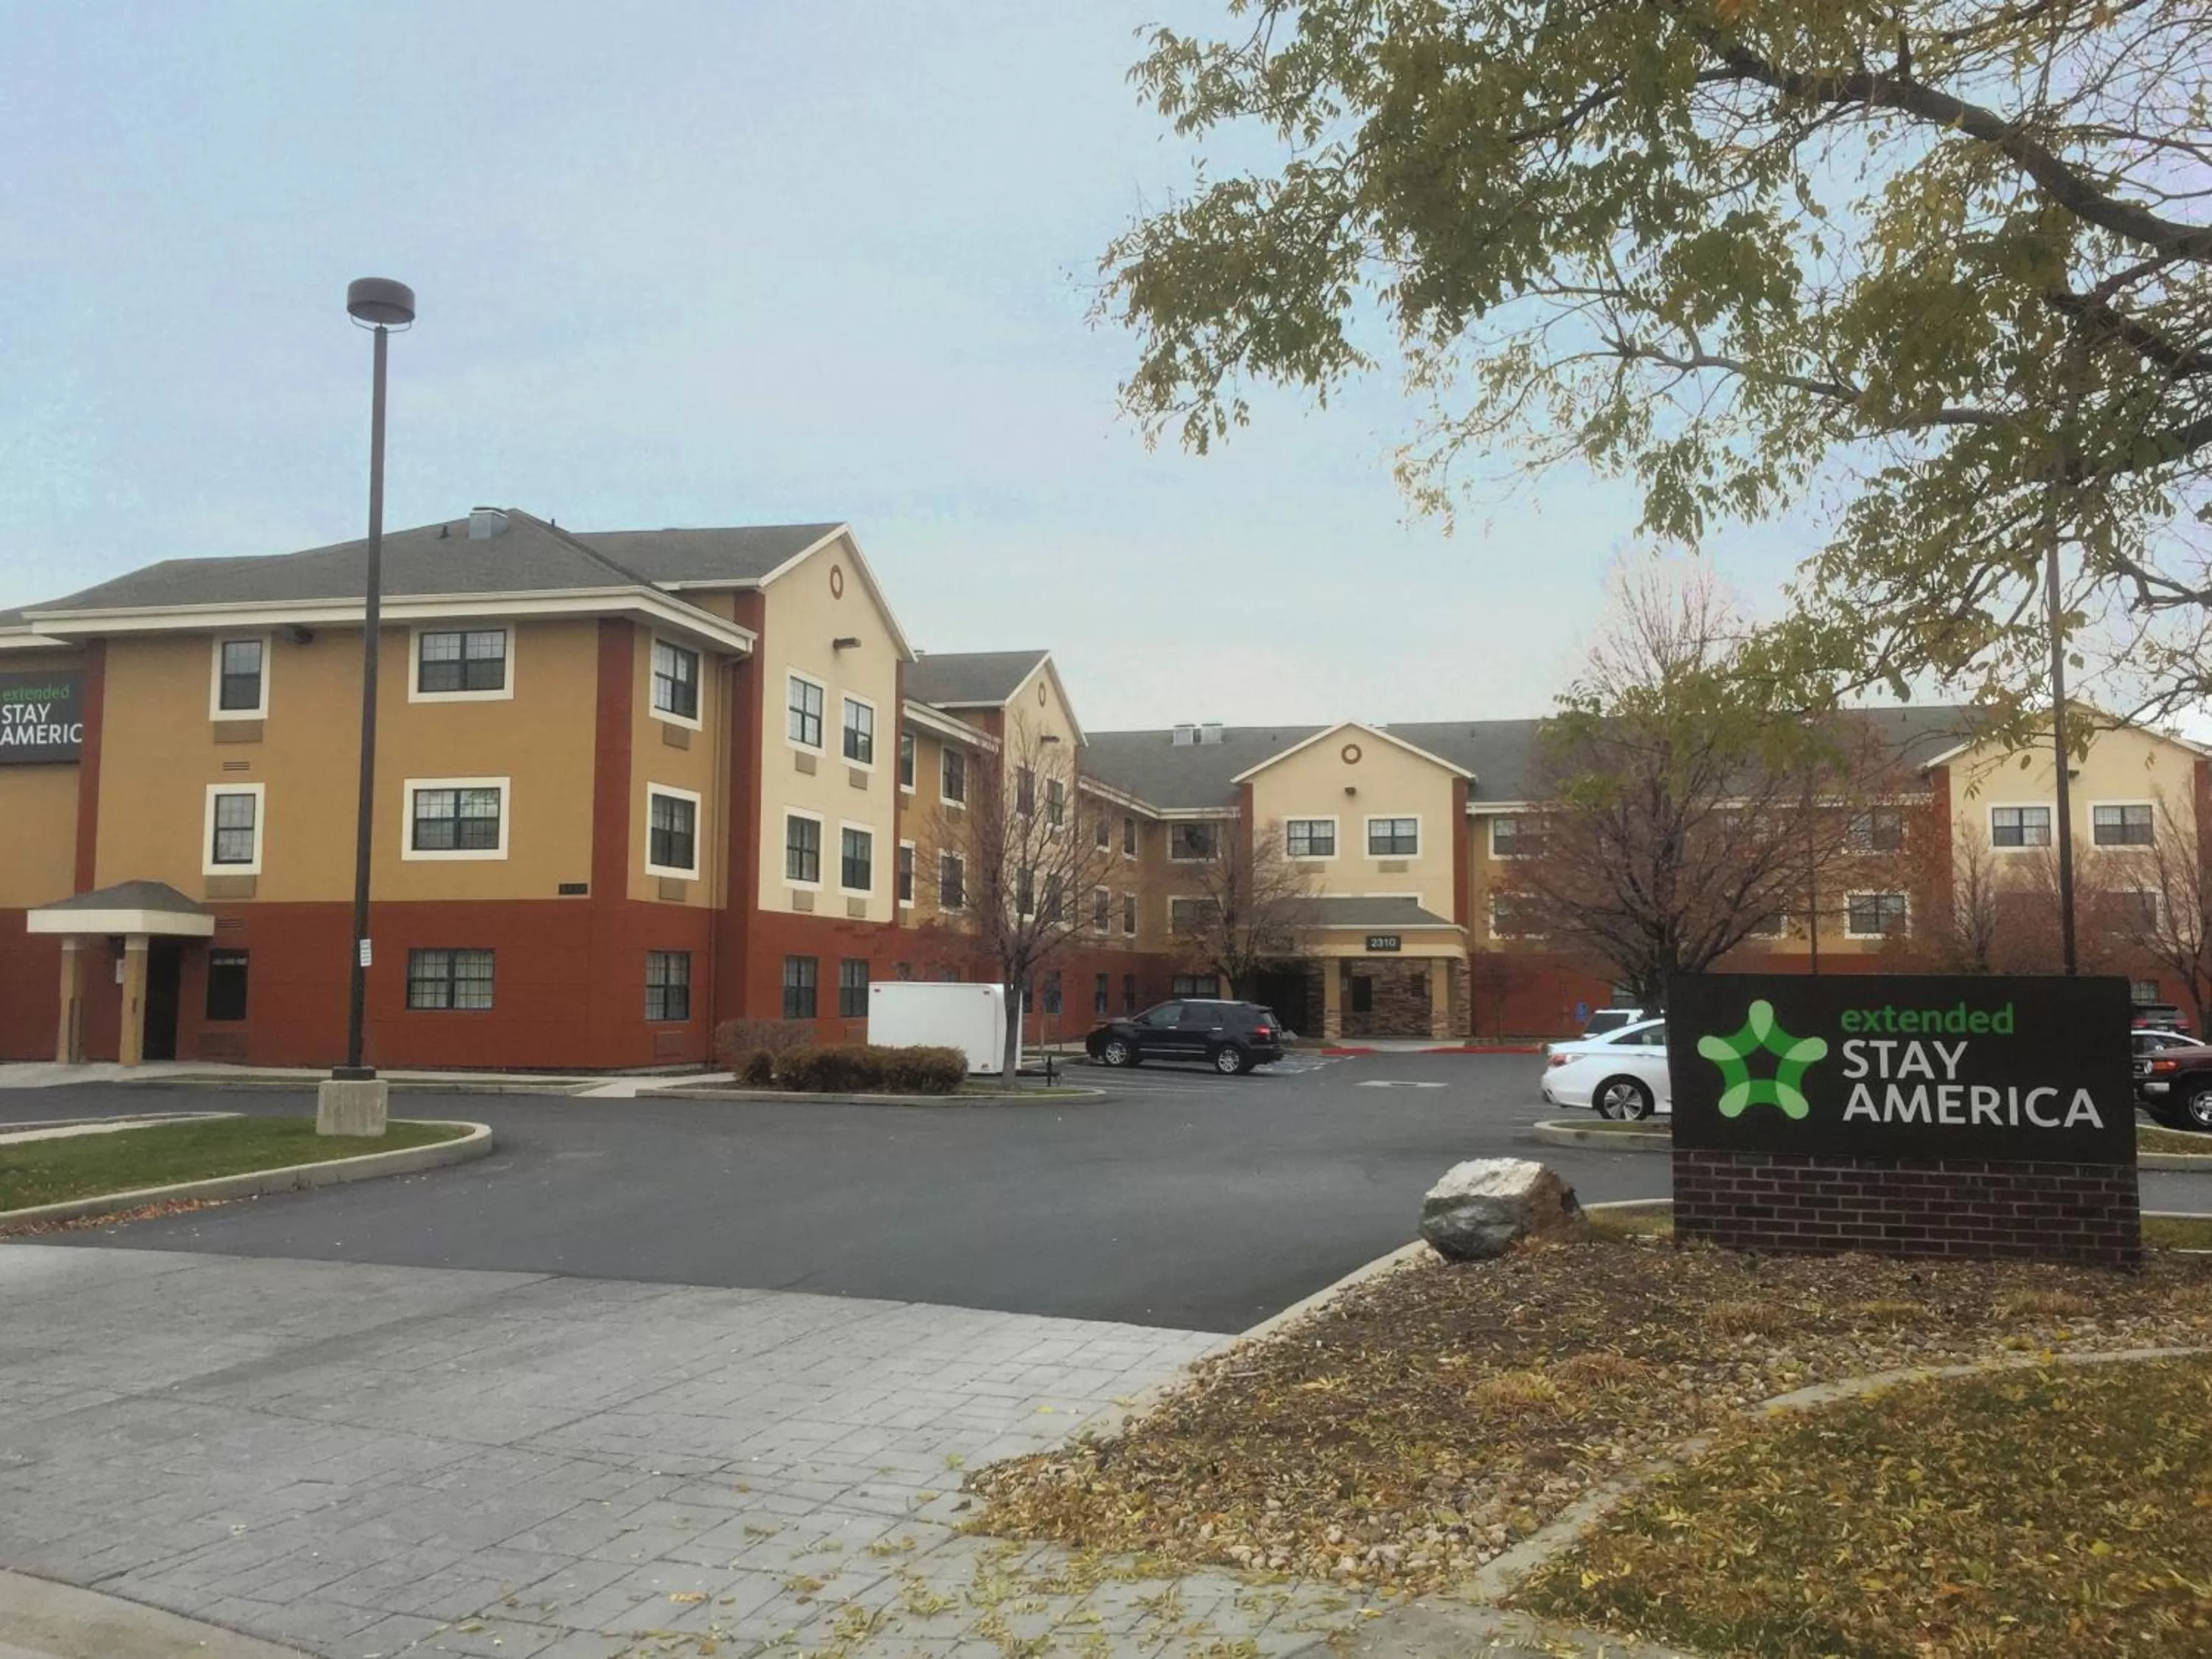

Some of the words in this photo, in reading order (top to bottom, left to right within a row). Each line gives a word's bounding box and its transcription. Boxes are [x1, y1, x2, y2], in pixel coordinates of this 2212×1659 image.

[2, 684, 69, 701] extended
[1, 703, 51, 724] STAY
[0, 723, 83, 745] AMERIC
[1840, 1001, 2014, 1034] extended
[1842, 1039, 1968, 1080] STAY
[1843, 1082, 2104, 1129] AMERICA
